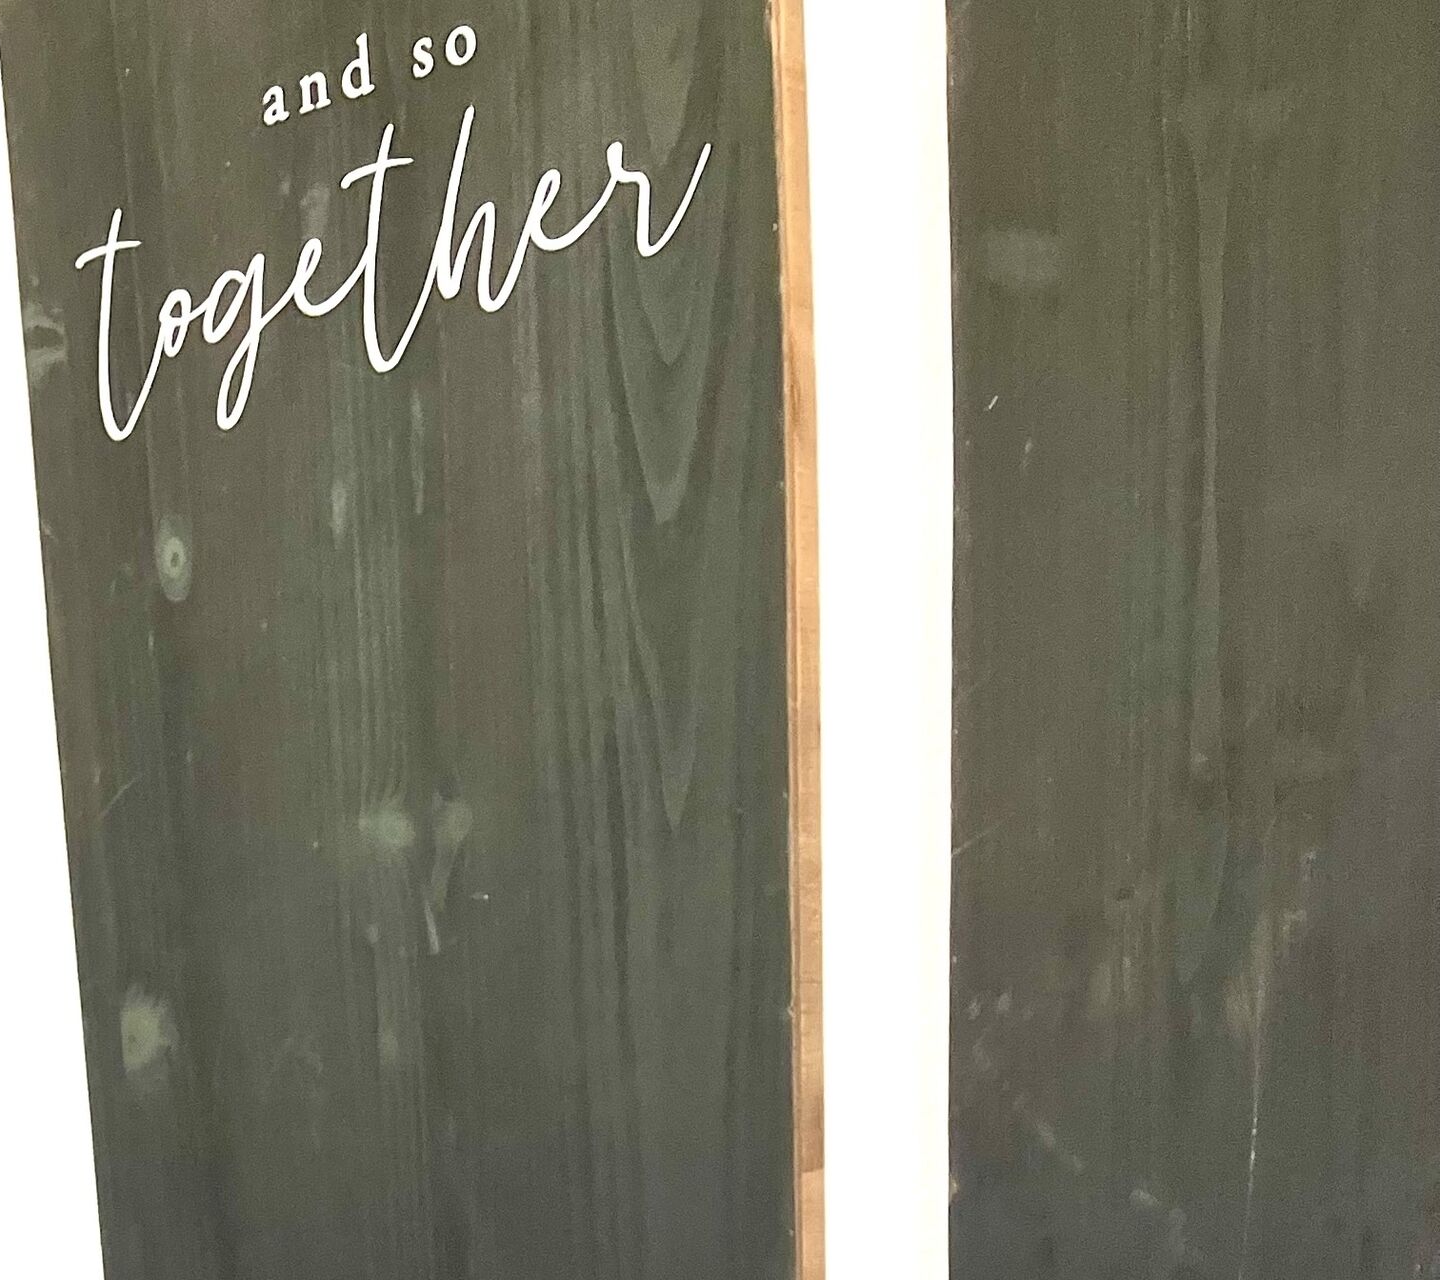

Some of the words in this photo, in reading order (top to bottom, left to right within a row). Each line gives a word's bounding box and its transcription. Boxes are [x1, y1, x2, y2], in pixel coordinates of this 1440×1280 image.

[262, 34, 375, 127] and
[412, 25, 478, 78] so
[75, 105, 712, 442] together
